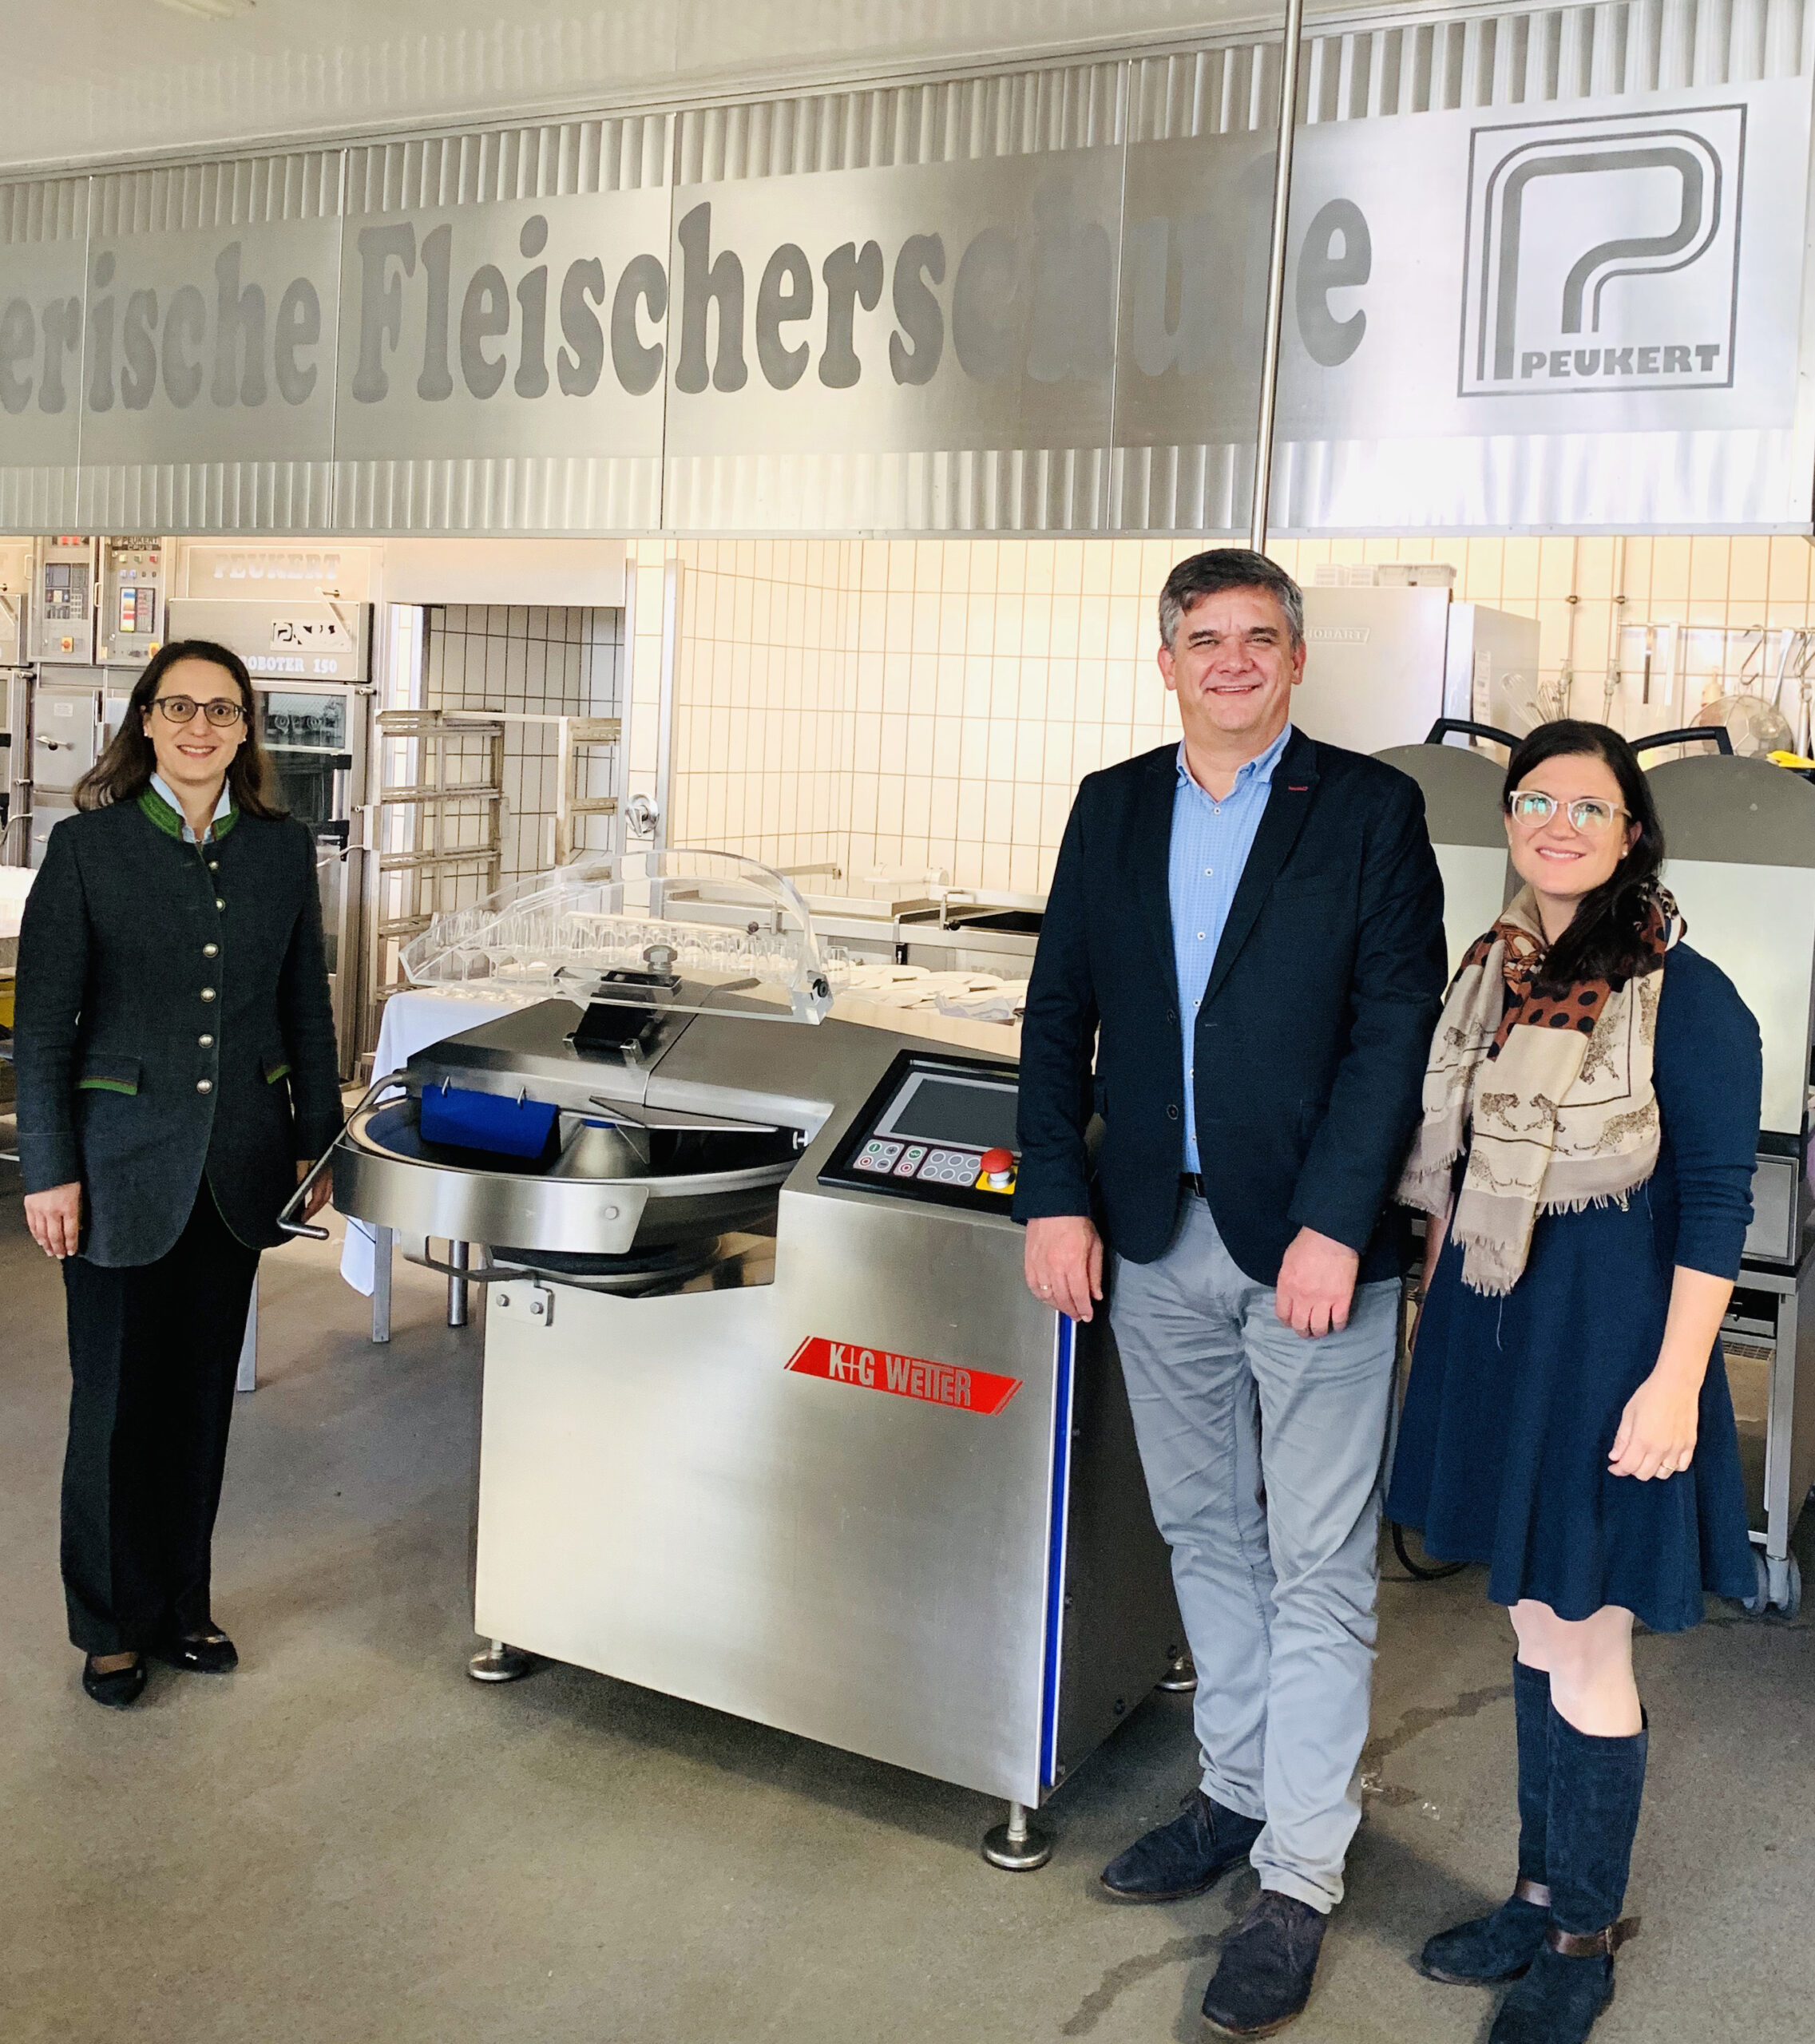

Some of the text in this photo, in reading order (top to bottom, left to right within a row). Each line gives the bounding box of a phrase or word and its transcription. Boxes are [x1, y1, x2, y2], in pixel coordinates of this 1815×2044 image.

[1521, 344, 1720, 378] PEUKERT
[213, 554, 341, 579] PEUKERT
[313, 658, 338, 673] 150
[829, 1343, 875, 1386] K+G
